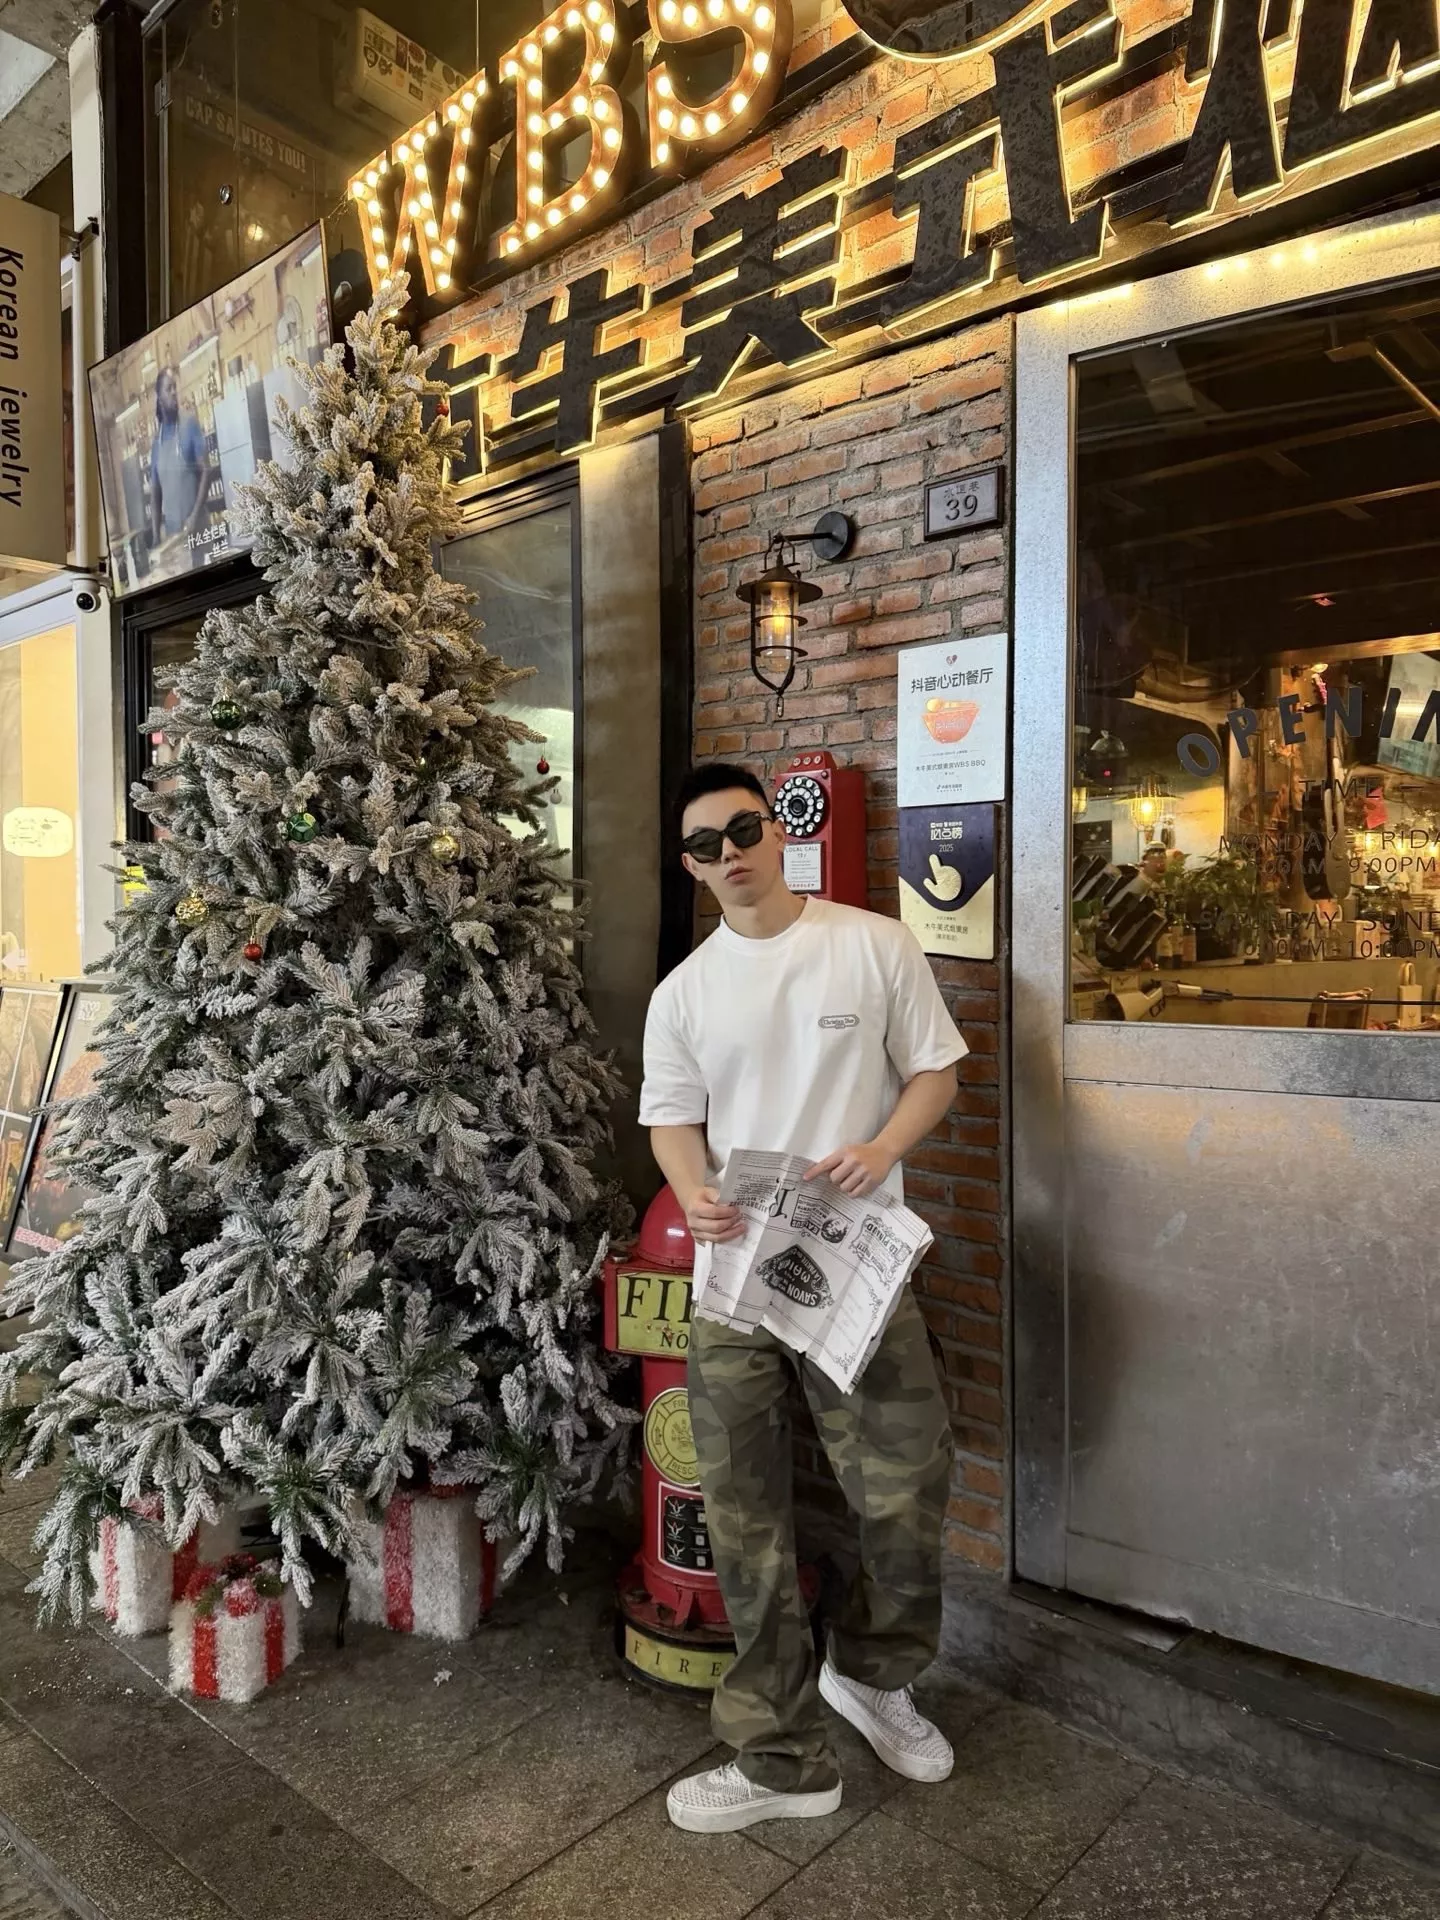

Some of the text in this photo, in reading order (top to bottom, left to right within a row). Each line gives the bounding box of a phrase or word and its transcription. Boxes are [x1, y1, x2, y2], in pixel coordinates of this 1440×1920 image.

[185, 95, 307, 174] CAP SAUTES YOU!
[347, 0, 791, 297] WBS
[0, 246, 29, 508] Korean jewelry
[945, 494, 978, 521] 39
[911, 667, 994, 693] 抖音心动餐厅
[1298, 777, 1381, 801] TIME
[930, 827, 963, 841] 必点榜
[1219, 831, 1337, 853] MONDAY
[1348, 856, 1436, 874] 9:00PM
[786, 1285, 819, 1307] SAVON
[634, 1640, 722, 1677] FIRE
